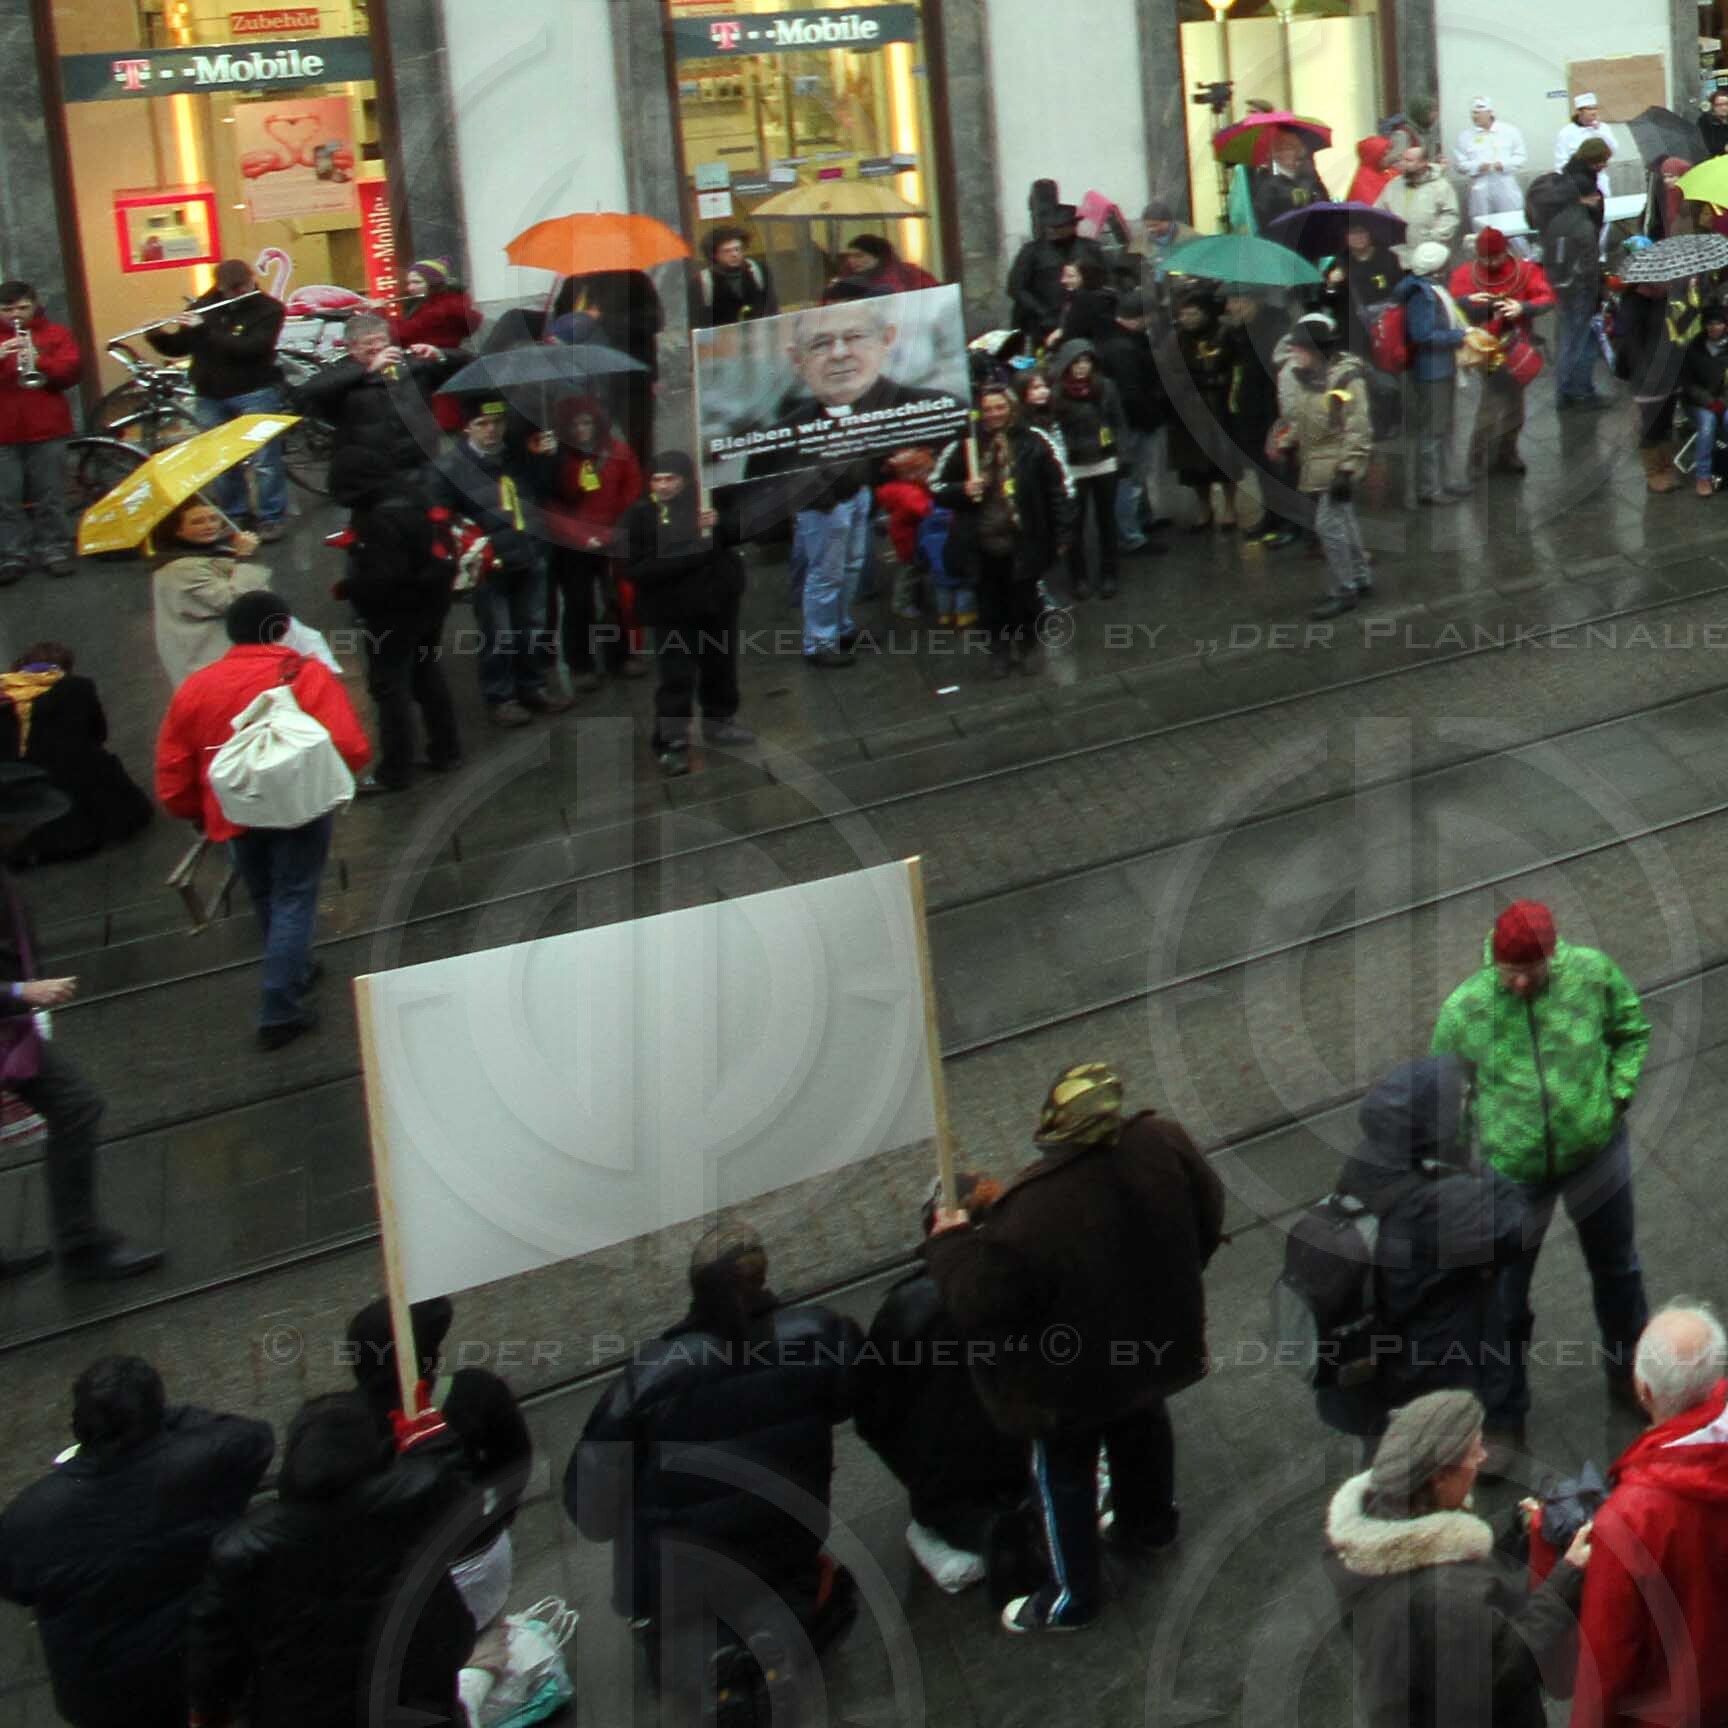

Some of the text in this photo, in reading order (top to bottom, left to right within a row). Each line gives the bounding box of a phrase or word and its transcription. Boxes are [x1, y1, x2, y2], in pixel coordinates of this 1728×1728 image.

[232, 10, 319, 33] Zubehör
[710, 426, 792, 453] Bleiben
[797, 418, 834, 436] wir
[839, 396, 956, 428] menschlich
